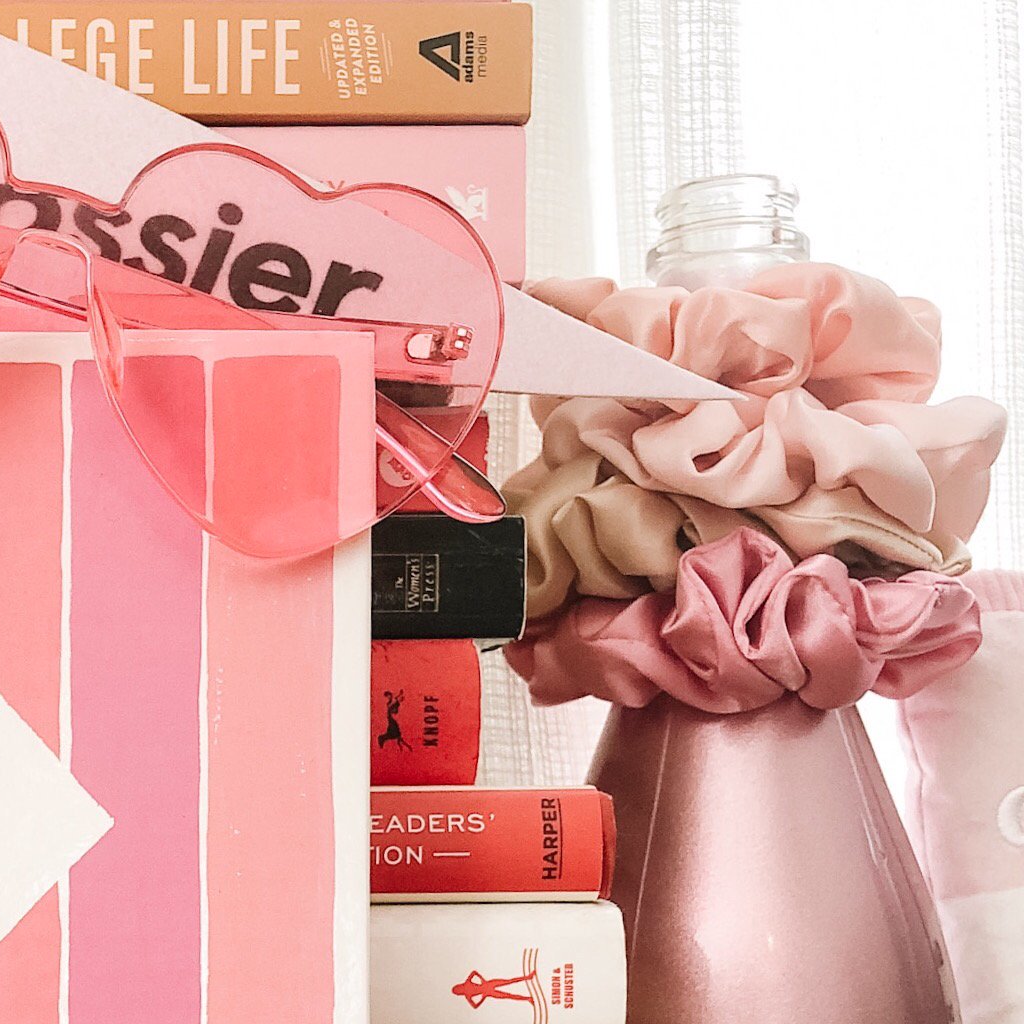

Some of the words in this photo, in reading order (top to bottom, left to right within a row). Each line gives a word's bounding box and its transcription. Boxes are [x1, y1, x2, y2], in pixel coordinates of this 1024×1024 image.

[328, 19, 342, 29] &
[183, 18, 301, 95] LIFE
[330, 32, 351, 99] UPDATED
[345, 18, 367, 96] EXPANDED
[362, 23, 383, 84] EDITION
[462, 31, 475, 83] adams
[476, 35, 488, 78] media
[407, 557, 421, 609] Women's
[422, 562, 436, 604] Press
[423, 695, 439, 747] KNOPF
[370, 846, 424, 865] ION
[542, 797, 558, 881] HARPER
[551, 976, 560, 1005] SIMON
[564, 963, 573, 1009] SCHUSTER
